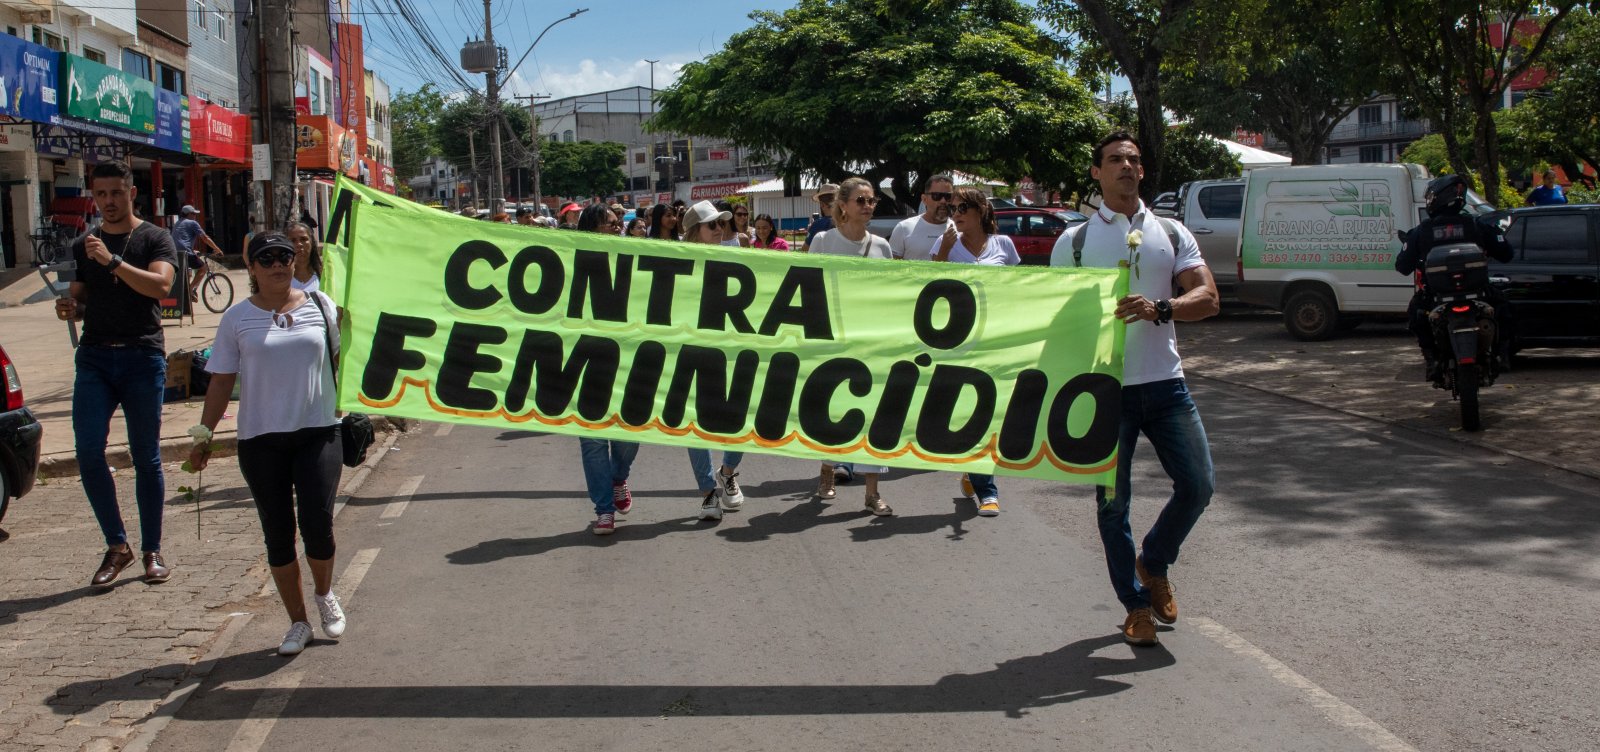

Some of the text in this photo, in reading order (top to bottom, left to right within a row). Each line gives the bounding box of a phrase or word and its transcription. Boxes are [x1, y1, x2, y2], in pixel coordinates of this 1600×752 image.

[23, 51, 51, 72] OPTIMUM
[1257, 216, 1338, 235] PARANOÁ
[1265, 235, 1389, 251] AGROPECUÁRIA
[1328, 253, 1392, 263] 3369-5787
[444, 239, 977, 350] CONTRA O
[361, 312, 1123, 464] FEMINICÍDIO
